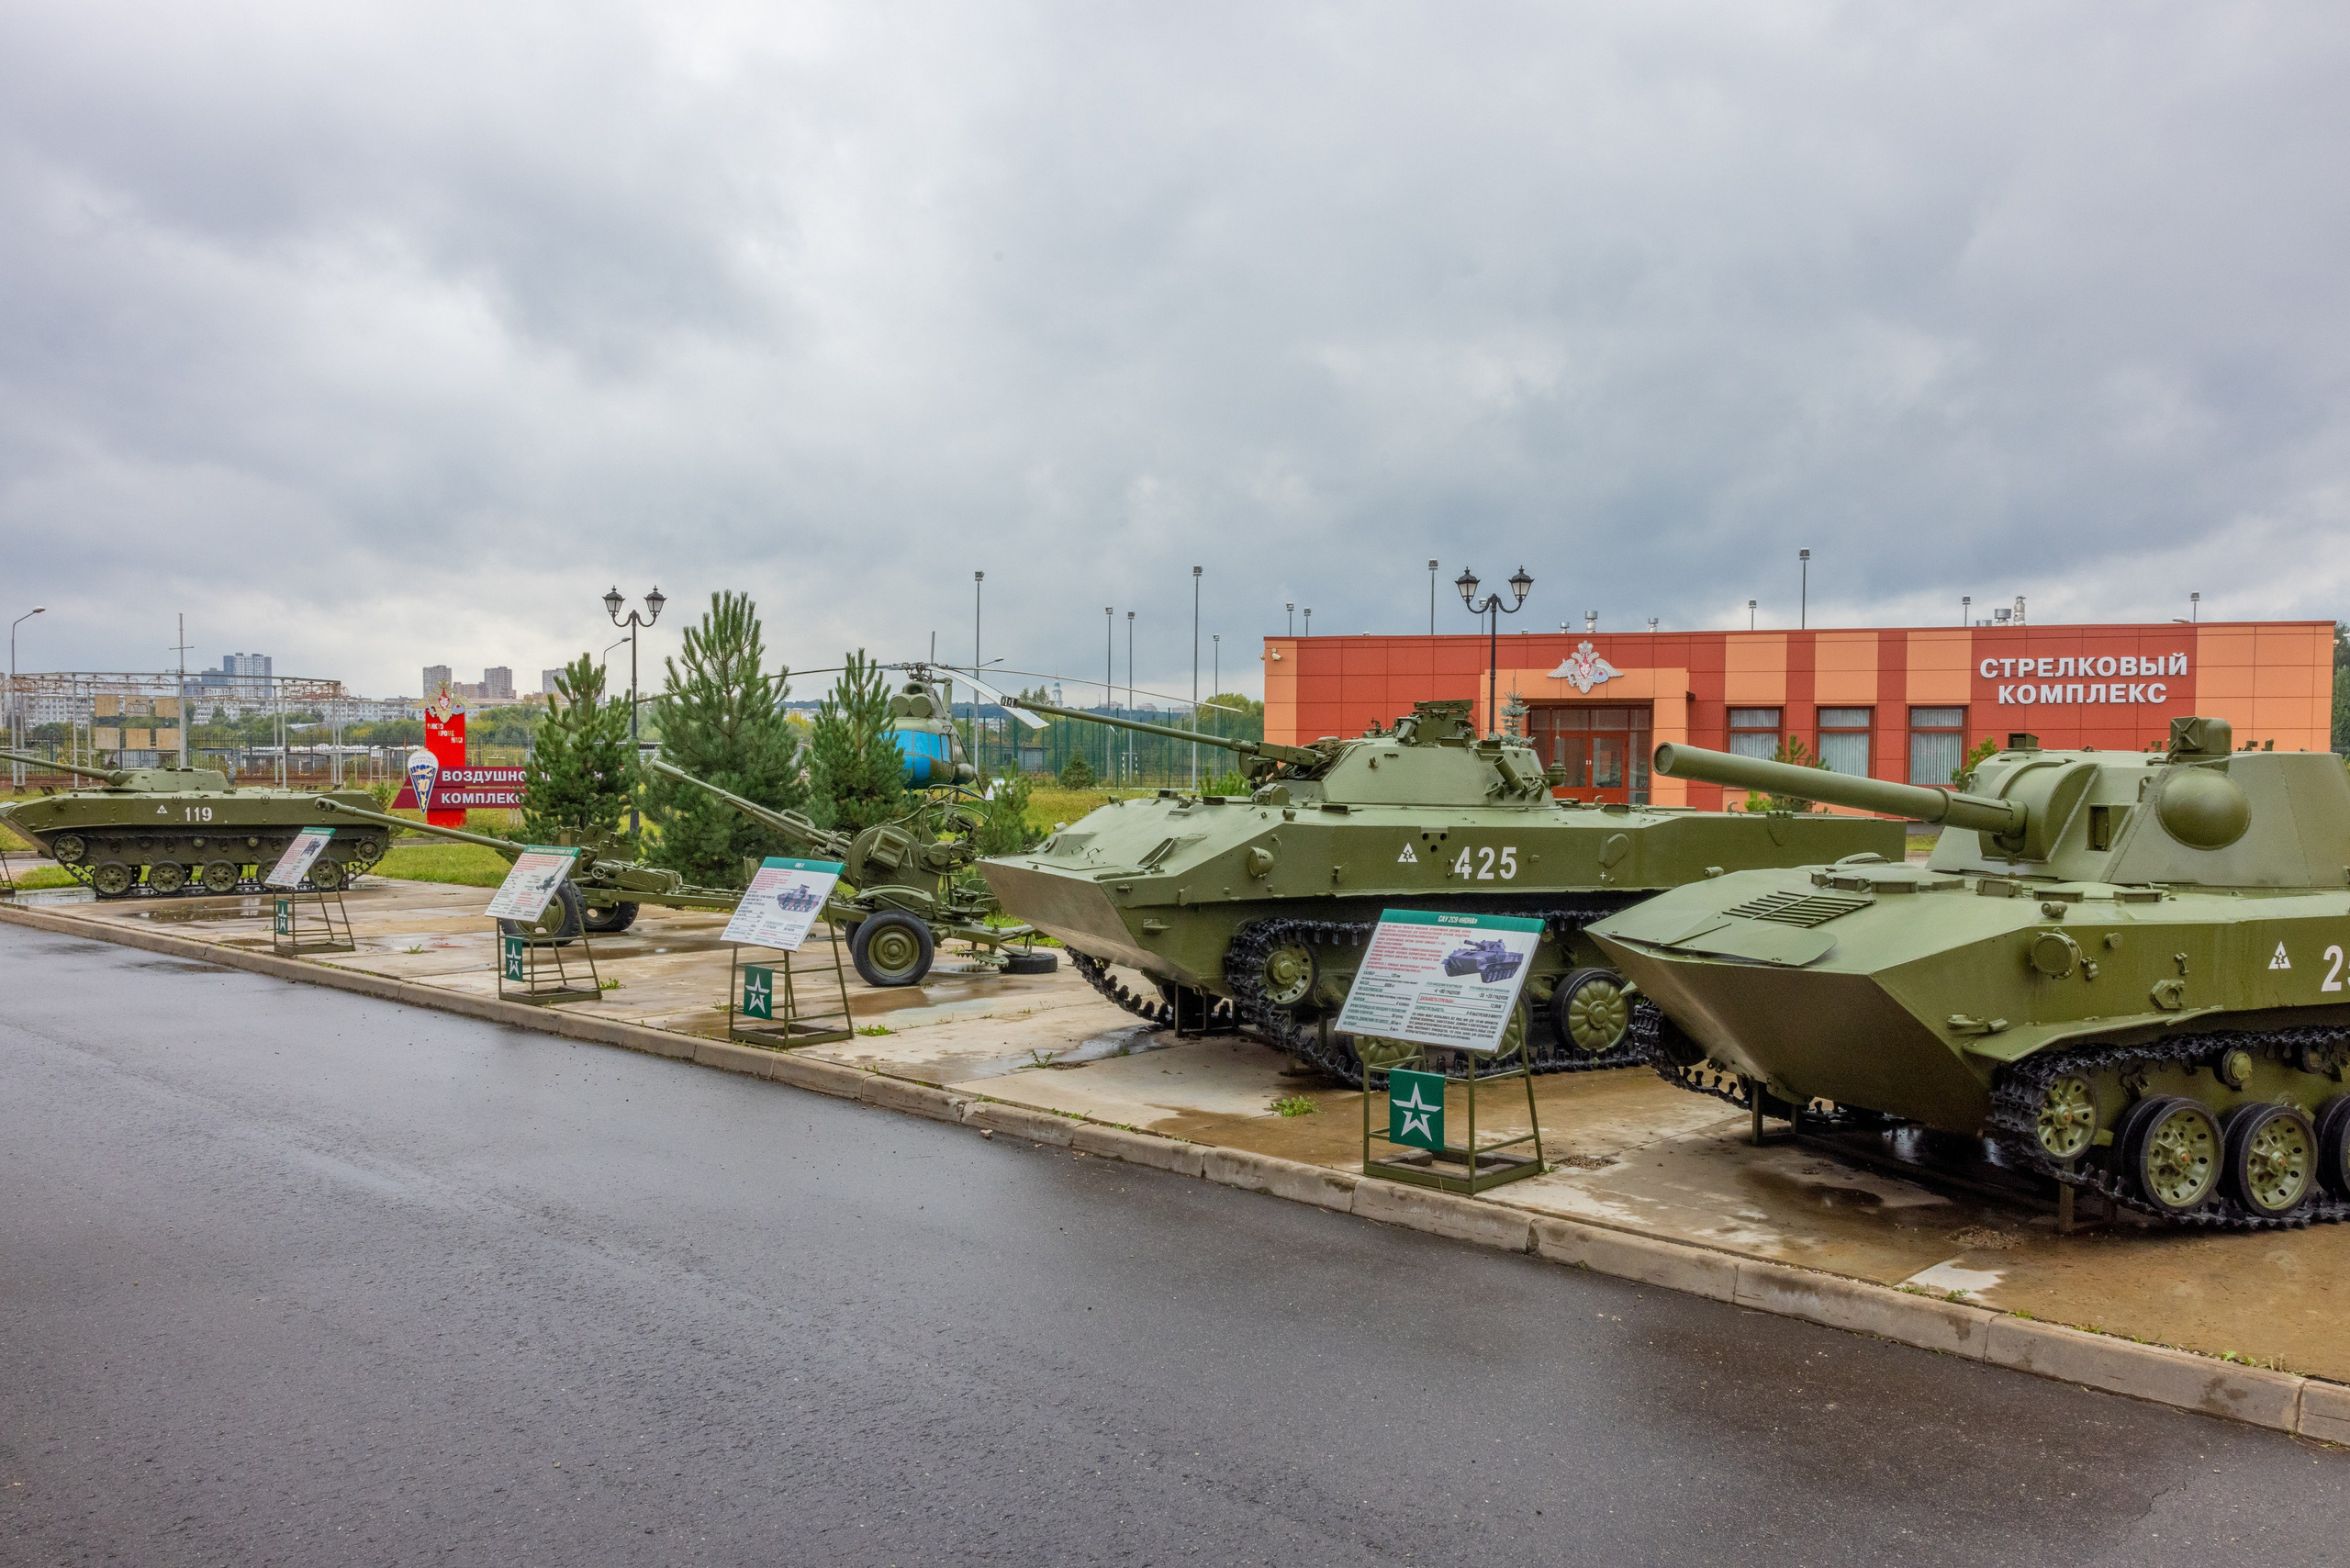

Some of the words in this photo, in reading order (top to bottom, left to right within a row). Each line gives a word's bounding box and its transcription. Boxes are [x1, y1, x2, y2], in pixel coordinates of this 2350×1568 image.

[1979, 653, 2188, 678] СТРЕЛКОВЫЙ
[1998, 683, 2167, 704] КОМПЛЕКС
[185, 806, 213, 822] 119
[1454, 846, 1517, 879] 425
[2321, 945, 2350, 991] 2
